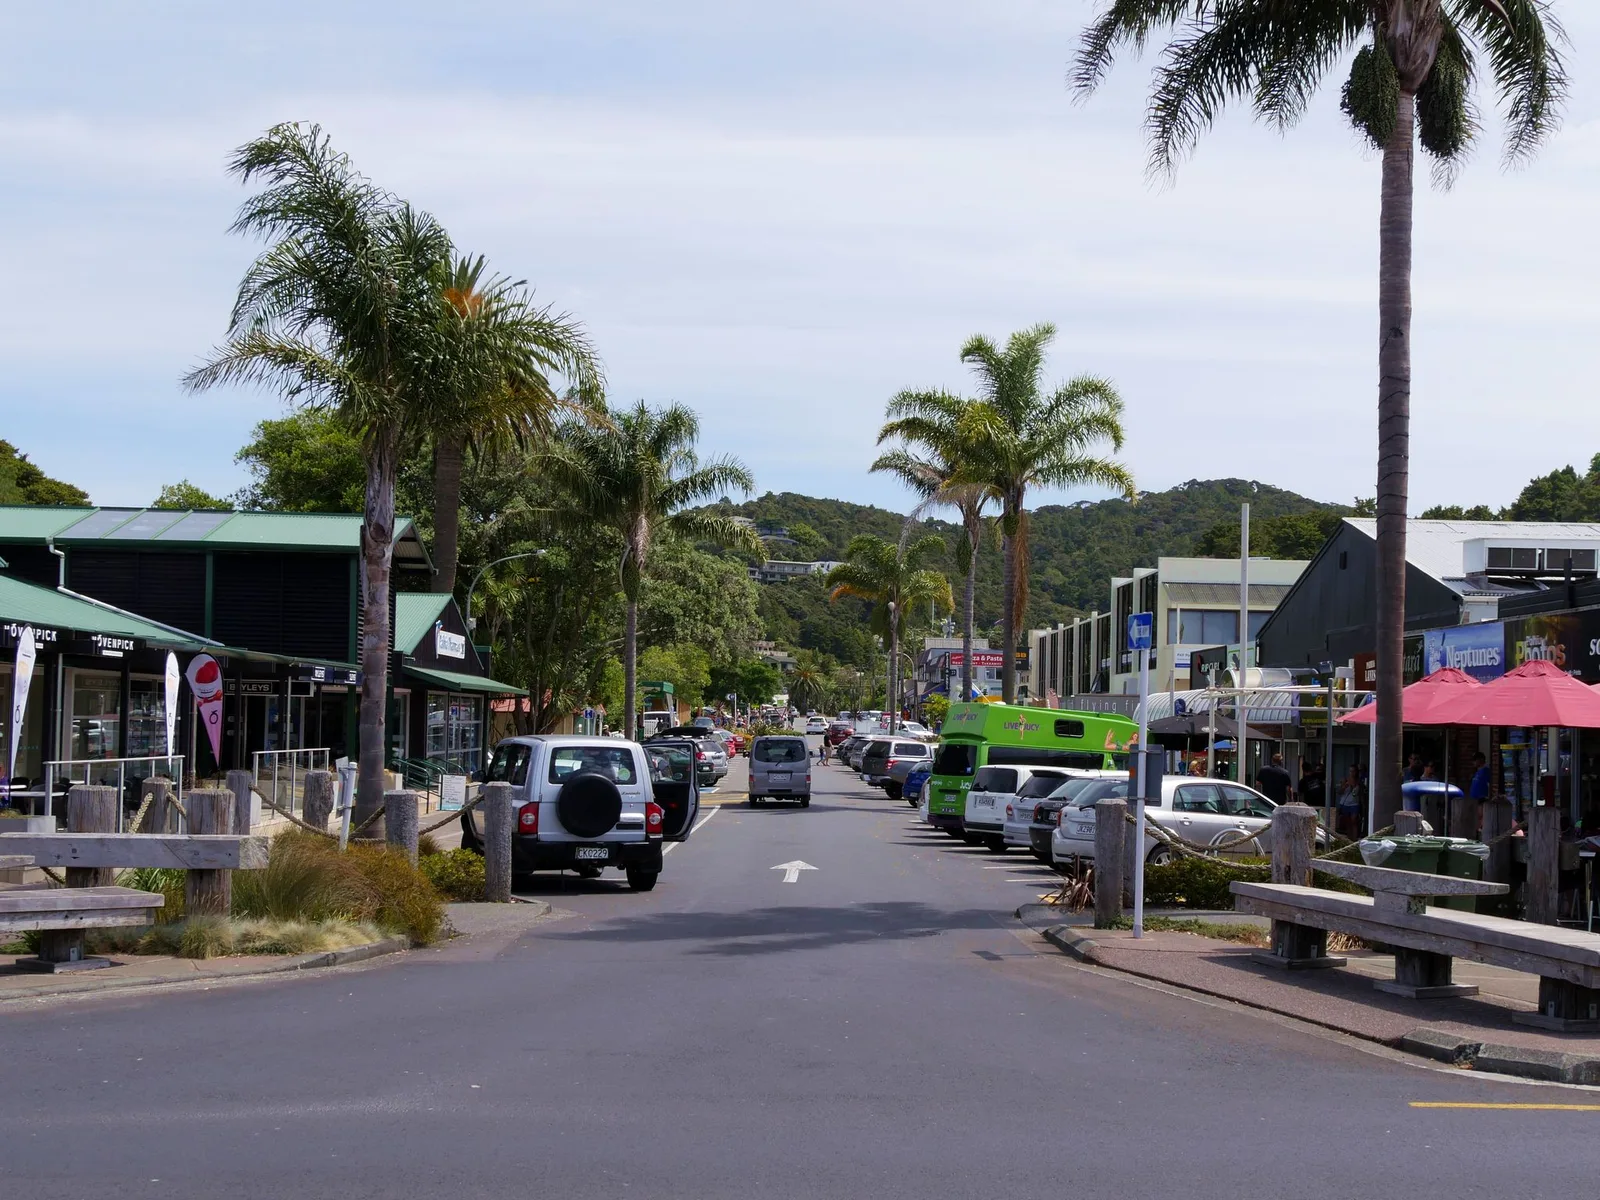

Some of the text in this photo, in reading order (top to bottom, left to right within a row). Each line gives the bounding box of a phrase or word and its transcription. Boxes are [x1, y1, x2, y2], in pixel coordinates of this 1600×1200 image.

[1446, 645, 1500, 669] Neptunes
[1516, 640, 1566, 666] Photos
[229, 683, 270, 692] BYLEYS
[1080, 698, 1117, 714] flying
